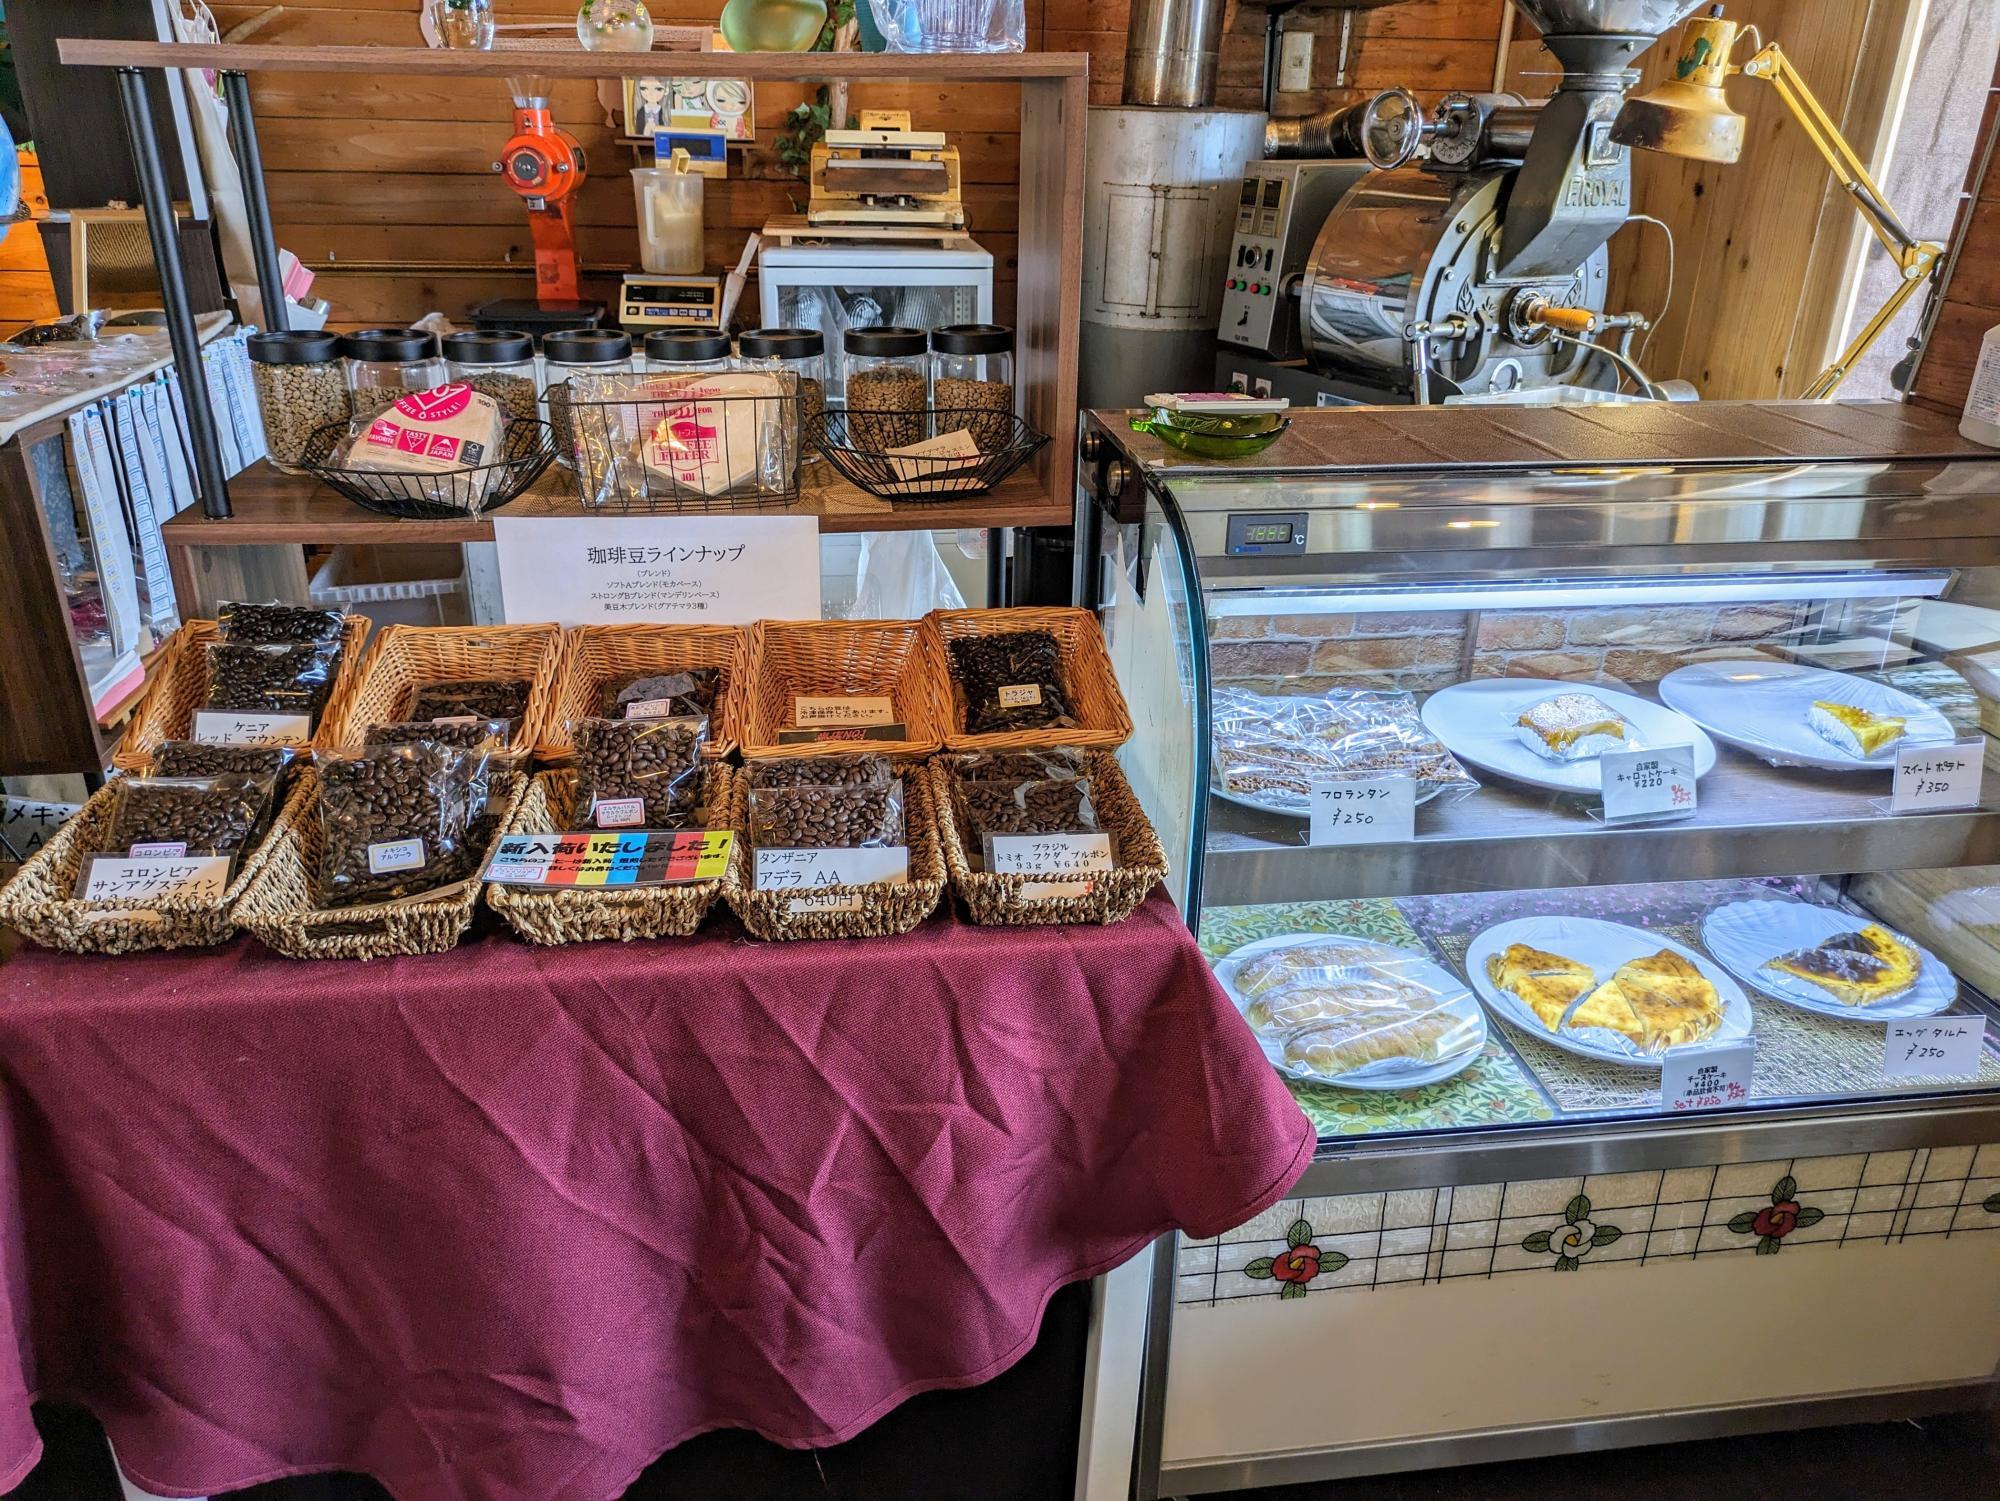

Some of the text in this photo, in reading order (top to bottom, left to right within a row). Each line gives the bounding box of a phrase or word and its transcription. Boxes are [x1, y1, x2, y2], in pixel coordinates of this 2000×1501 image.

[587, 543, 746, 565] 珈琲豆ラインナップ
[234, 721, 270, 732] ケニア
[198, 732, 306, 745] レッド マウンテン
[1636, 760, 1659, 772] 自家製
[1617, 768, 1678, 782] キャロットケーキ
[1634, 778, 1663, 788] ¥220
[1915, 778, 1949, 797] ¥350
[1320, 789, 1391, 800] フロランタン
[1332, 807, 1374, 826] ¥250
[134, 848, 181, 857] コロンビア
[500, 839, 729, 855] 新入荷いたしました！
[1032, 842, 1069, 851] ブラジル
[760, 852, 818, 864] タンザニア
[996, 852, 1023, 862] トミオ
[1034, 851, 1061, 861] フクダ
[1016, 861, 1043, 869] 93g
[120, 866, 199, 879] コロンビア
[760, 870, 841, 885] アデラ AA
[93, 879, 220, 892] サンアグスティン
[1905, 1042, 1945, 1061] ¥250
[1697, 1065, 1718, 1075] 自家製
[1694, 1079, 1719, 1088] ¥400
